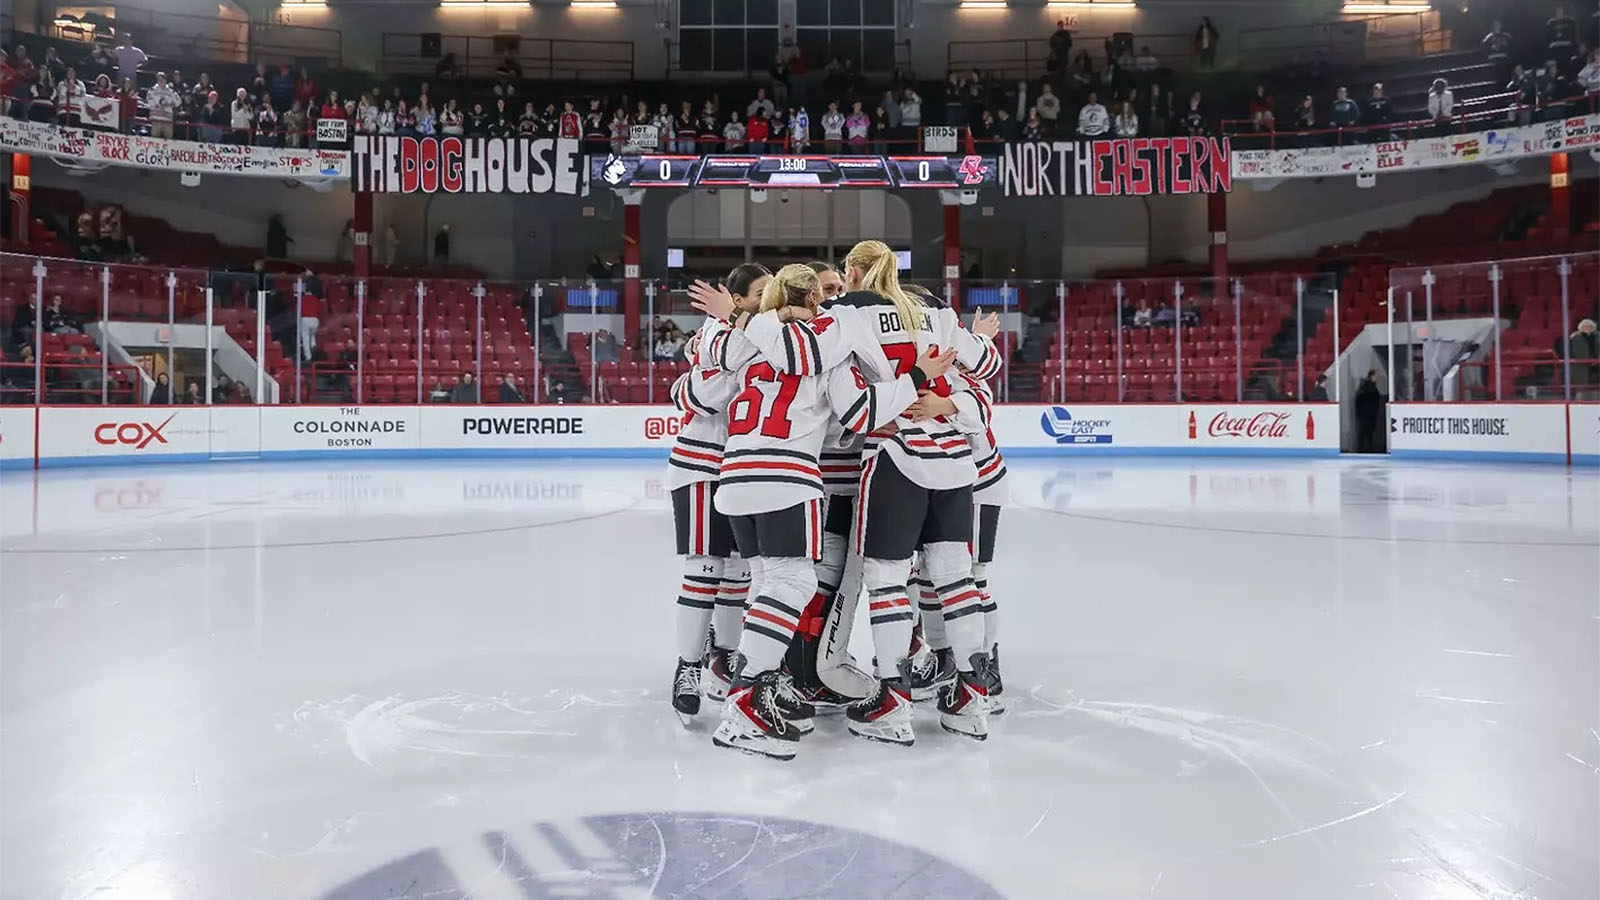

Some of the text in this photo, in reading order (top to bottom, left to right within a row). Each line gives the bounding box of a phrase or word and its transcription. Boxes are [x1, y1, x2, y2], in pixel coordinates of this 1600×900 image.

[318, 120, 345, 129] NOT FROM
[1565, 117, 1586, 128] MORE
[318, 128, 346, 139] BOSTON
[925, 126, 956, 138] BIRDS
[97, 134, 129, 148] STRYKE
[136, 153, 170, 166] GLORY
[779, 158, 806, 171] 13:00
[1377, 156, 1403, 168] ELLIE
[659, 160, 671, 180] 0
[918, 160, 930, 181] 0
[1004, 137, 1231, 196] NORTHEASTERN
[728, 360, 802, 439] 61
[340, 407, 360, 415] THE
[94, 411, 179, 450] COX
[293, 420, 406, 433] COLONNADE
[463, 417, 583, 435] POWERADE
[1402, 417, 1445, 434] PROTECT
[1448, 417, 1470, 435] THIS
[327, 438, 372, 447] BOSTON
